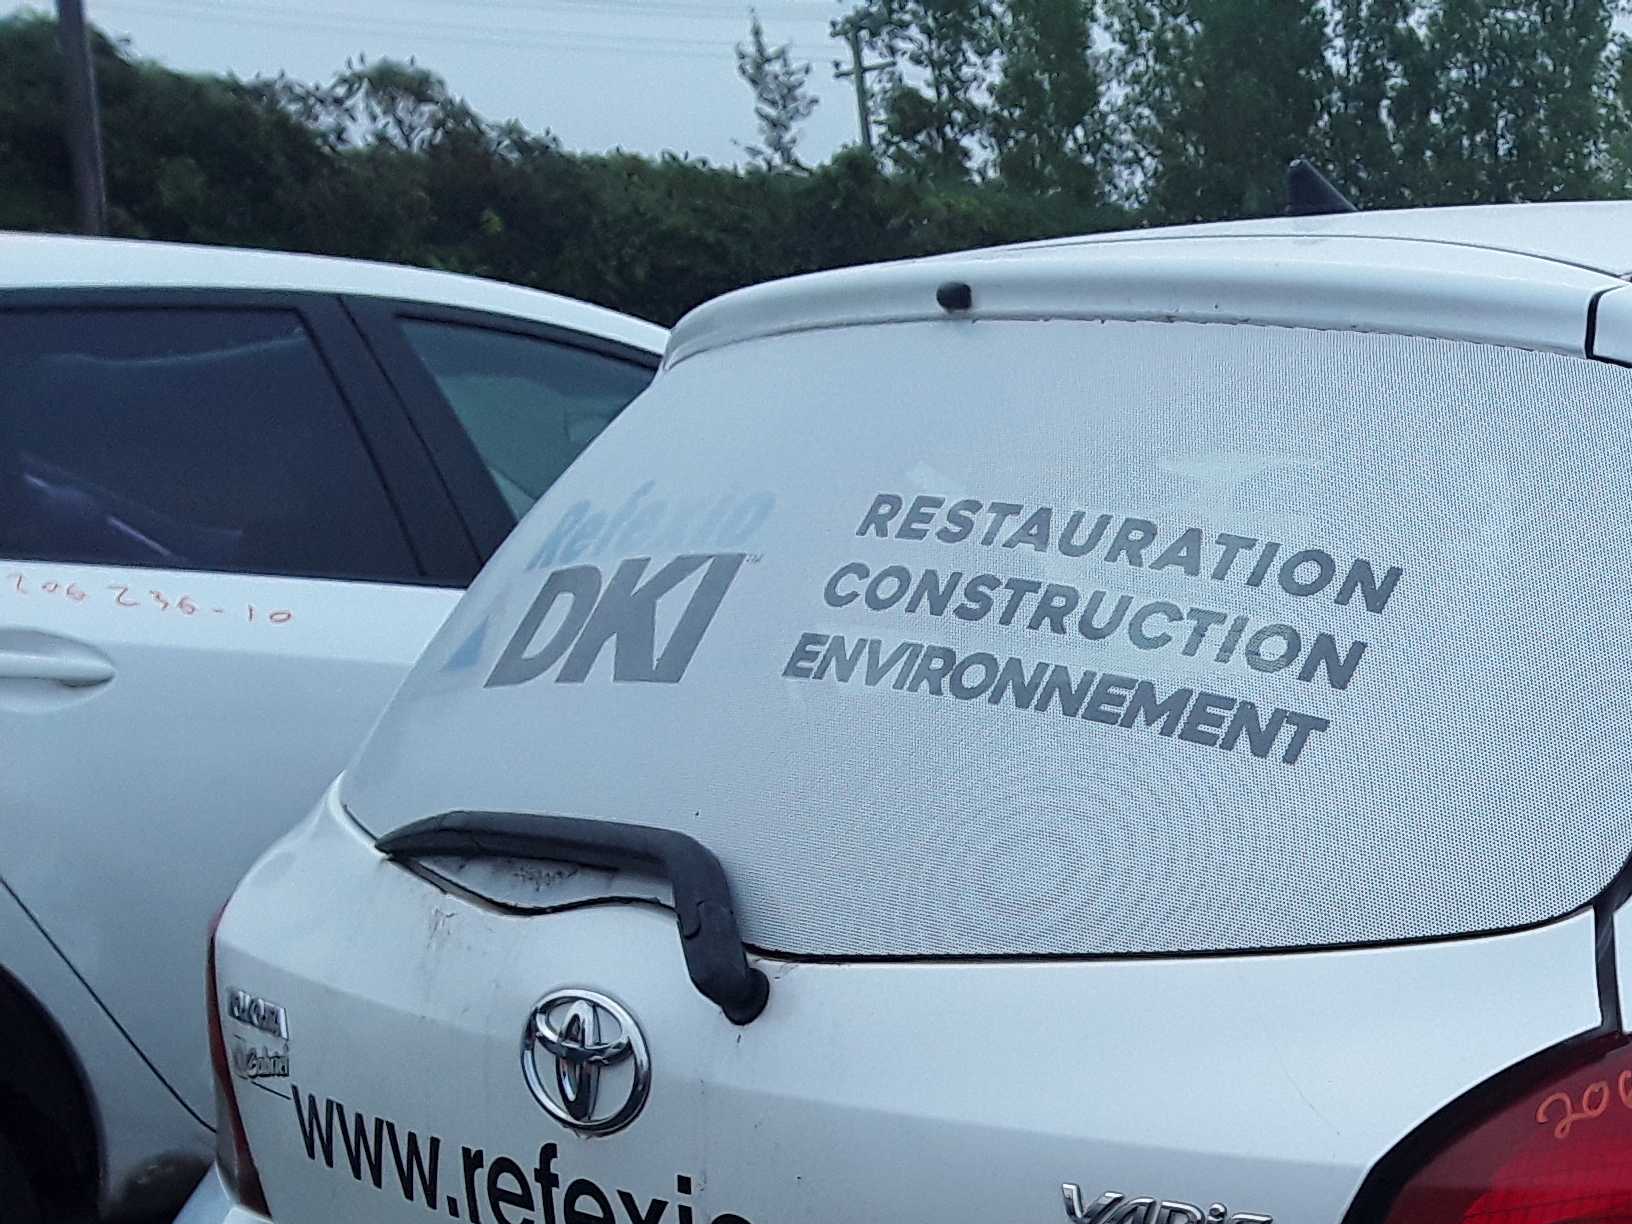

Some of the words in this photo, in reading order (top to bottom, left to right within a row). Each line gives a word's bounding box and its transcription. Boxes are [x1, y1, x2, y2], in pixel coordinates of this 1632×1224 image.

[855, 493, 1403, 614] RESTAURATION
[484, 552, 745, 688] DKI
[823, 561, 1367, 690] CONSTRUCTION
[781, 632, 1330, 764] ENVIRONNEMENT
